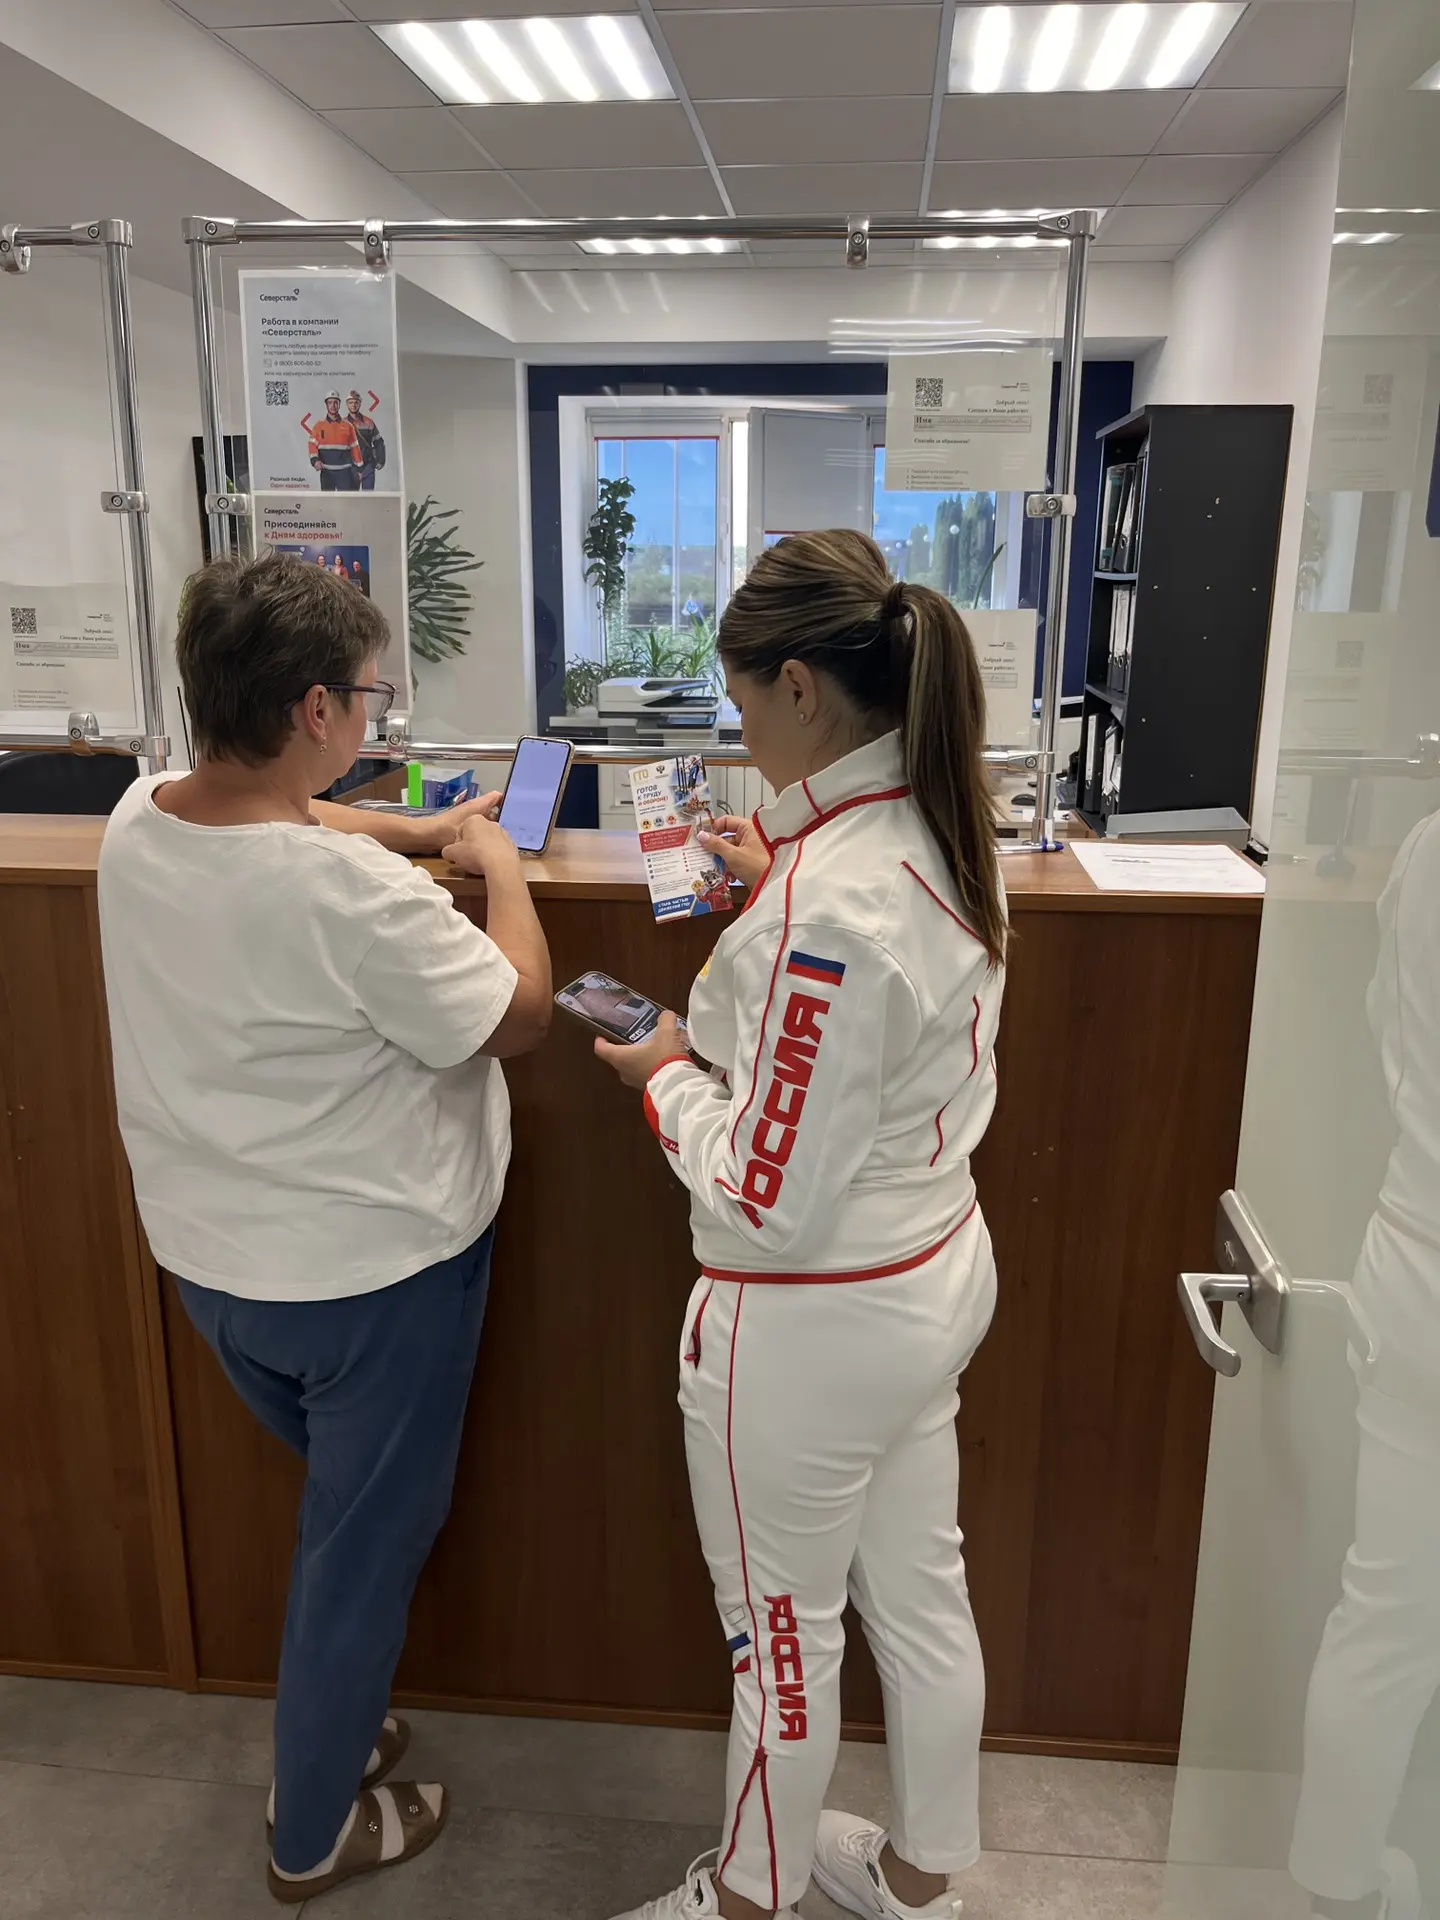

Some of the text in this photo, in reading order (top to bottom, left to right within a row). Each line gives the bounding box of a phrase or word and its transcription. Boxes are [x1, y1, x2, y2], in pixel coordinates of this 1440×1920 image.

[260, 294, 298, 302] Северсталь
[262, 328, 322, 337] «Северсталь»
[264, 520, 337, 529] Присоединяйся
[297, 532, 343, 540] здоровья!
[633, 769, 648, 782] ГТО
[636, 784, 658, 794] ГОТОВ
[643, 790, 662, 799] ТРУДУ
[736, 992, 831, 1230] ОССИЯ
